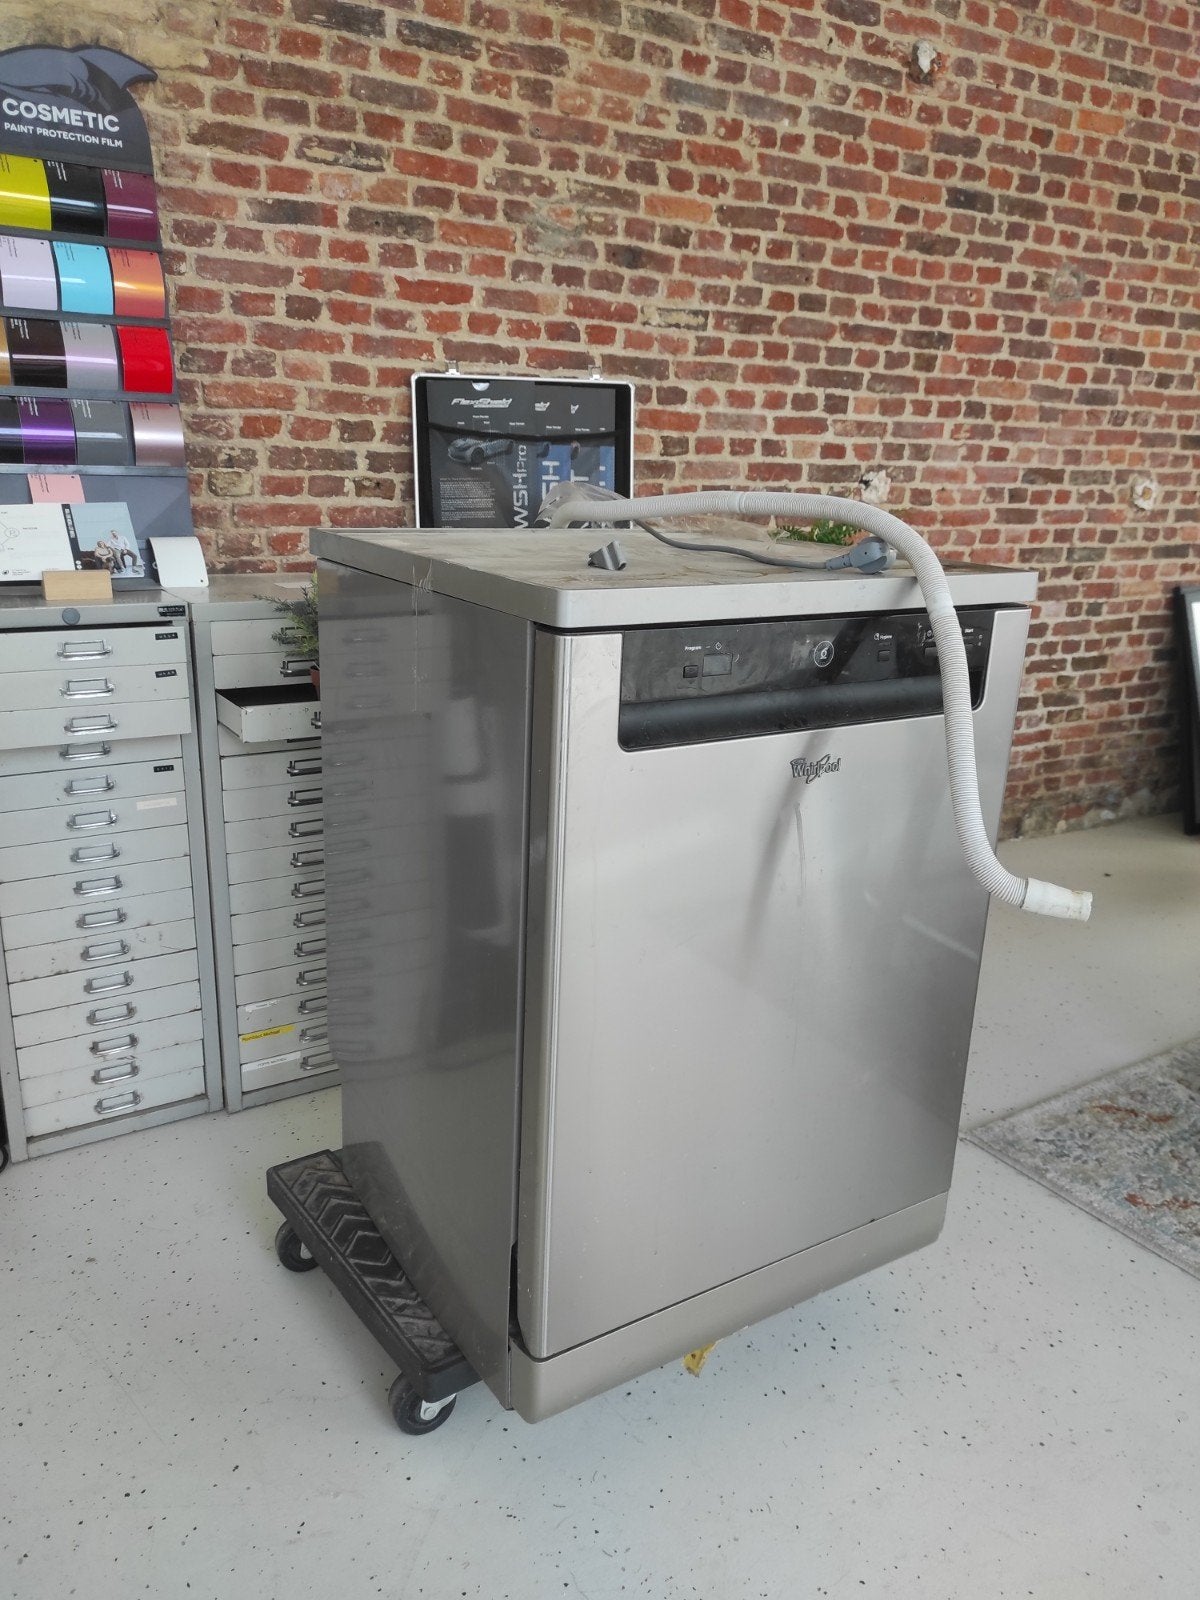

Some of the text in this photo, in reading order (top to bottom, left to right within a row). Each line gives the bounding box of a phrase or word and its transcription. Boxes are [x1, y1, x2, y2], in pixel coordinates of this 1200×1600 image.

[2, 98, 120, 133] COSMETIC
[4, 122, 123, 148] PAINT PROTECTION FILM
[789, 753, 842, 784] Whirlpool
